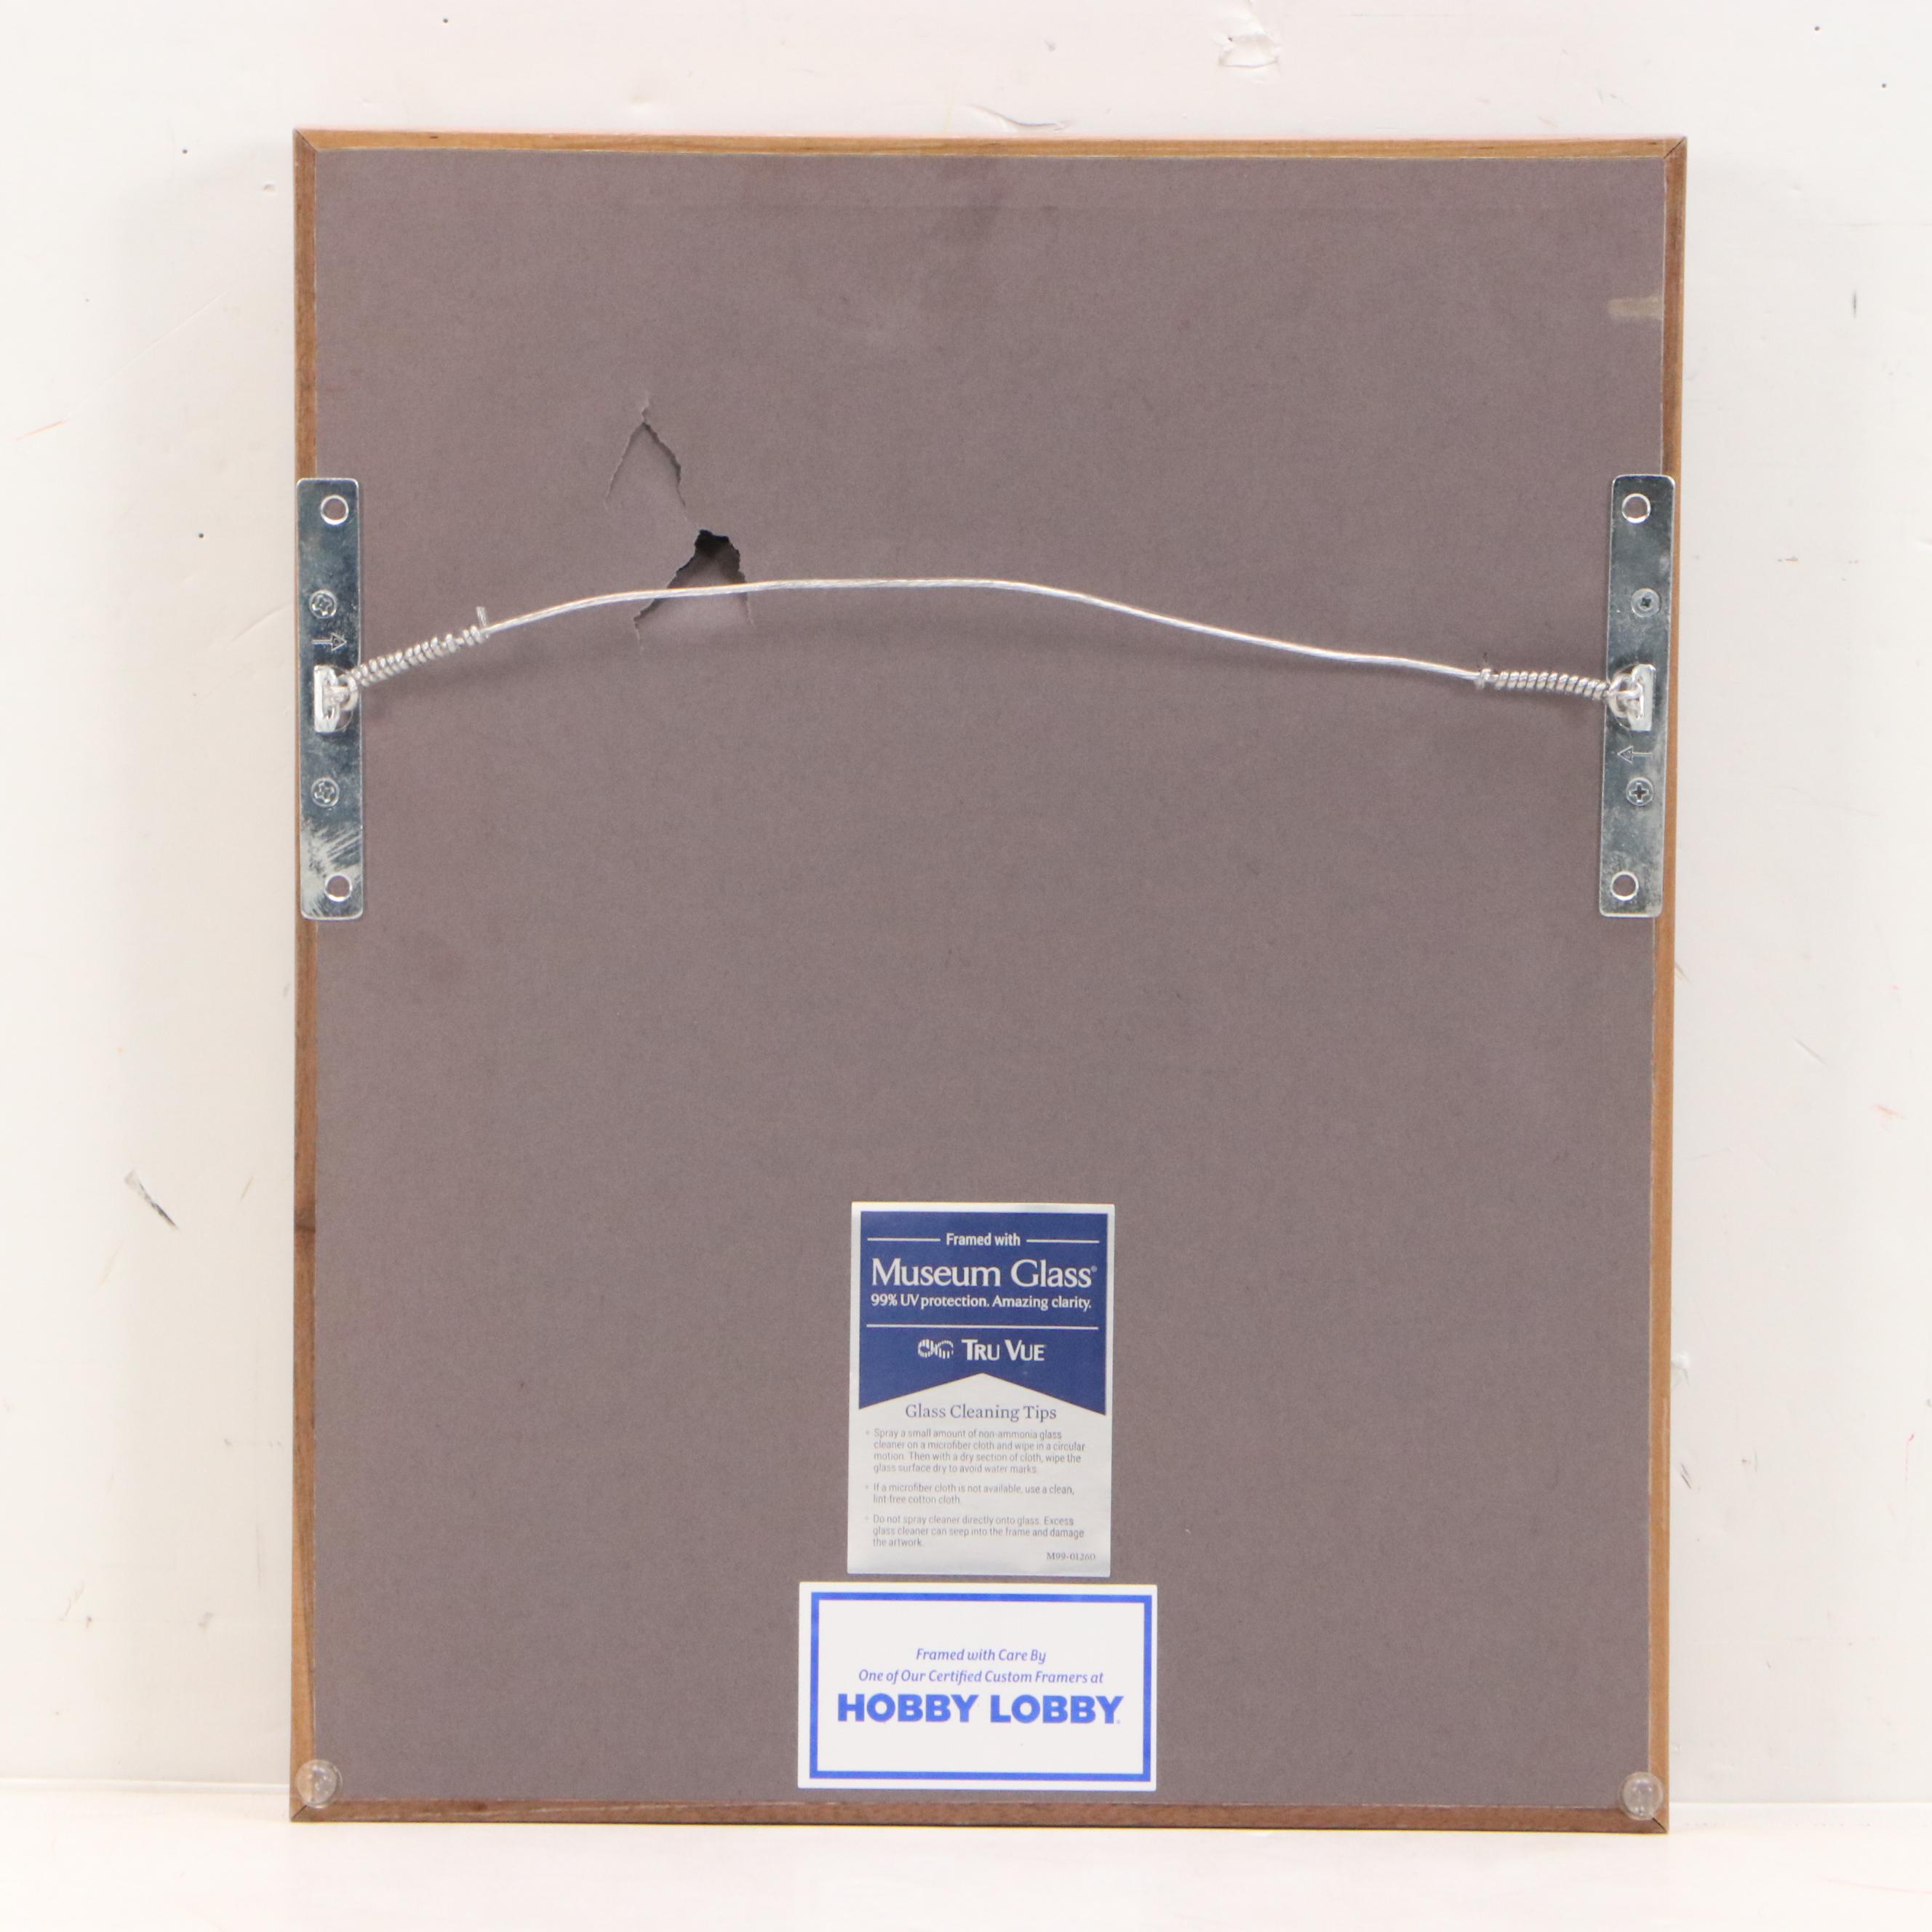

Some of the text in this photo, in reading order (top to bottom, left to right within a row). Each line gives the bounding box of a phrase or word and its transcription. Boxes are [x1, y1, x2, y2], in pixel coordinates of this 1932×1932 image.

[946, 1233, 1020, 1246] Framed with
[872, 1258, 1001, 1286] Museum
[871, 1294, 1091, 1312] 99% UV protection. Amazing clarity.
[906, 1405, 1056, 1421] Glass Cleaning Tips
[874, 1428, 898, 1439] Spray
[908, 1429, 931, 1437] small
[968, 1429, 977, 1437] of
[1039, 1429, 1062, 1440] glass
[874, 1440, 904, 1449] cleaner
[928, 1440, 970, 1450] microfiber
[973, 1440, 994, 1450] cloth
[997, 1442, 1013, 1450] and
[1015, 1442, 1034, 1451] wipe
[1053, 1442, 1085, 1451] circular
[909, 1452, 930, 1461] Then
[933, 1453, 950, 1461] with
[960, 1453, 973, 1463] dry
[976, 1453, 1007, 1461] section
[1010, 1453, 1018, 1461] of
[1046, 1454, 1065, 1464] wipe
[1067, 1454, 1081, 1463] the
[874, 1464, 896, 1474] glass
[898, 1464, 930, 1472] surface
[933, 1464, 946, 1474] dry
[959, 1464, 982, 1473] avoid
[874, 1482, 879, 1492] If
[889, 1482, 932, 1493] microfiber
[935, 1483, 956, 1493] cloth
[959, 1485, 965, 1493] is
[967, 1484, 981, 1493] not
[1049, 1485, 1074, 1496] clean,
[908, 1496, 936, 1504] cotton
[873, 1514, 885, 1523] Do
[887, 1515, 901, 1524] not
[929, 1515, 959, 1524] cleaner
[962, 1515, 994, 1526] directly
[996, 1517, 1015, 1525] onto
[1044, 1516, 1074, 1525] Excess
[873, 1526, 895, 1536] glass
[898, 1527, 928, 1536] cleaner
[949, 1528, 969, 1538] seep
[972, 1528, 987, 1536] into
[989, 1527, 1002, 1536] the
[1005, 1527, 1030, 1536] frame
[1032, 1528, 1047, 1537] and
[1050, 1528, 1084, 1540] damage
[873, 1538, 886, 1547] the
[916, 1648, 1046, 1664] Framed with Care By
[858, 1670, 1103, 1685] One of Our Certified Custom Framers at
[837, 1693, 1123, 1724] HOBBY LOBBY
